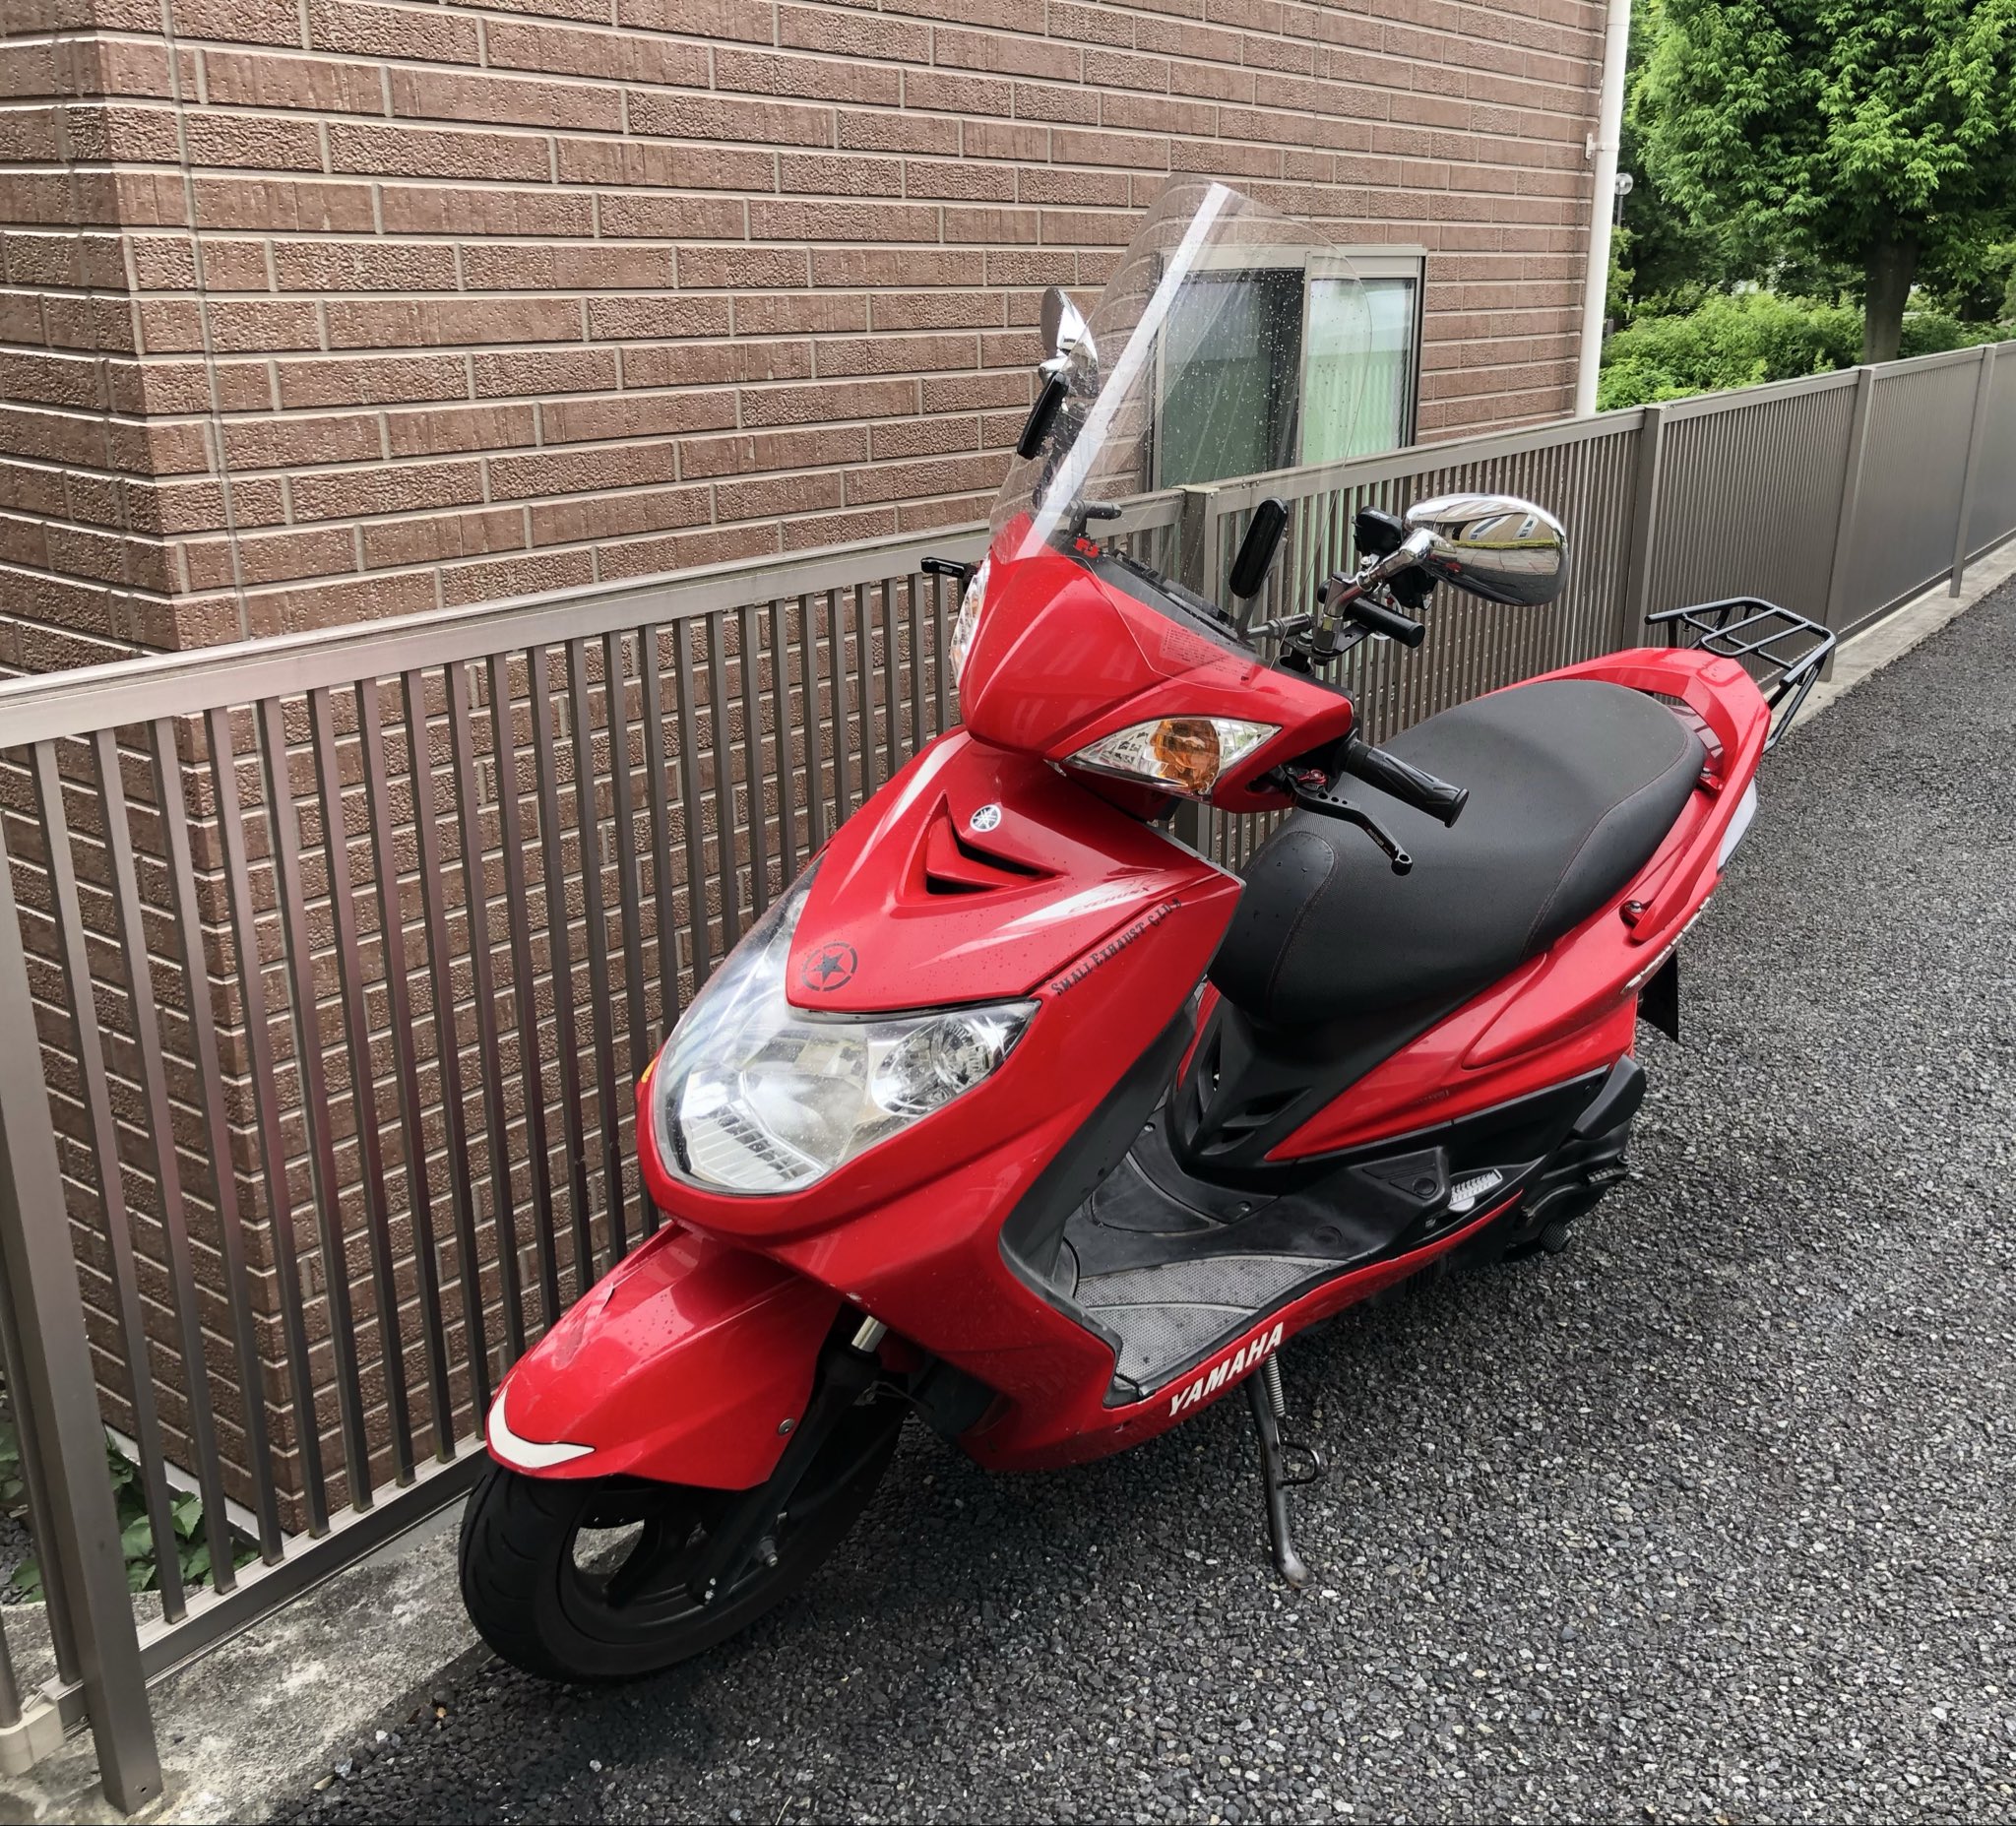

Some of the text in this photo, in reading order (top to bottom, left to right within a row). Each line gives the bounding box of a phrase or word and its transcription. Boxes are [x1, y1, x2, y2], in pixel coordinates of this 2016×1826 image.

[1051, 961, 1094, 996] SMALL
[1091, 922, 1147, 968] EXHAUST
[1168, 1322, 1285, 1417] YAMAHA
